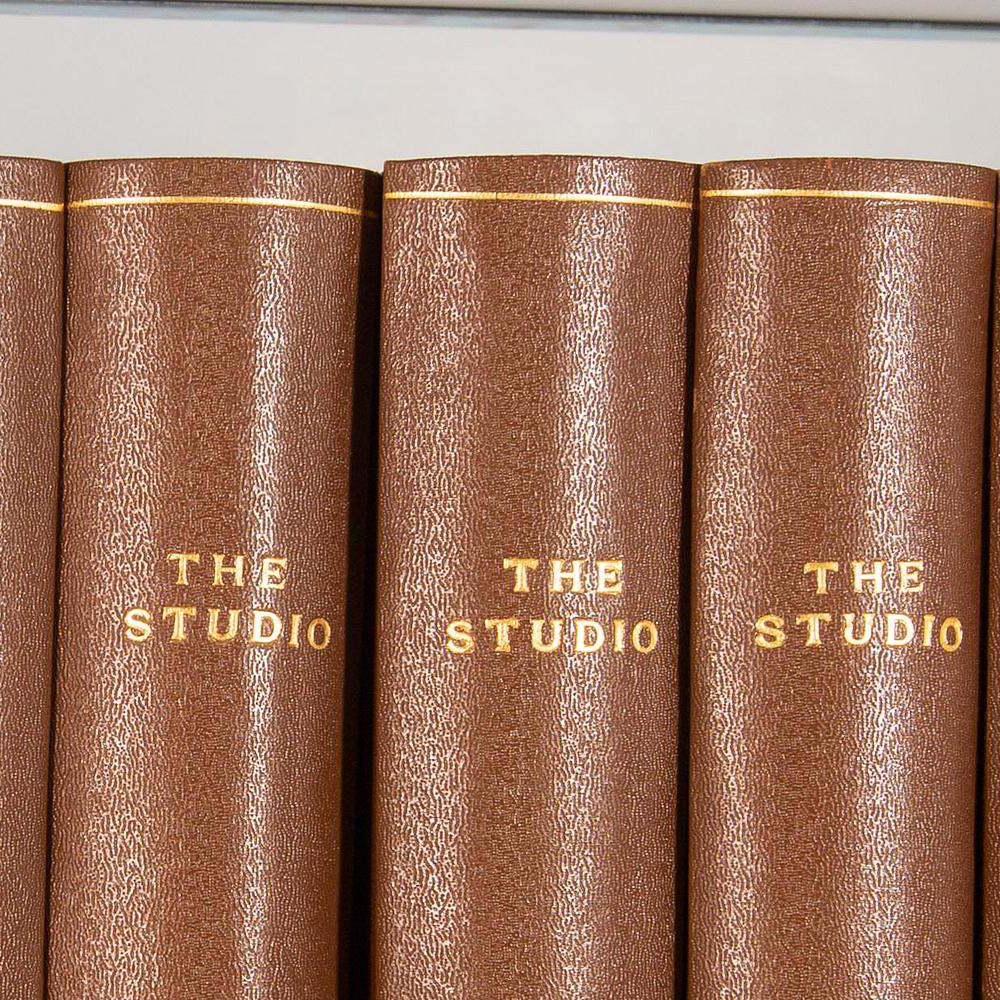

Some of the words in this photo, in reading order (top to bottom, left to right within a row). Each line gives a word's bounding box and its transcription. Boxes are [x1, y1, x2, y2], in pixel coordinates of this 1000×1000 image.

[168, 553, 288, 590] THE
[503, 558, 624, 597] THE
[804, 560, 925, 596] THE
[124, 607, 332, 650] STUDIO
[446, 618, 659, 655] STUDIO
[755, 612, 963, 653] STUDIO
